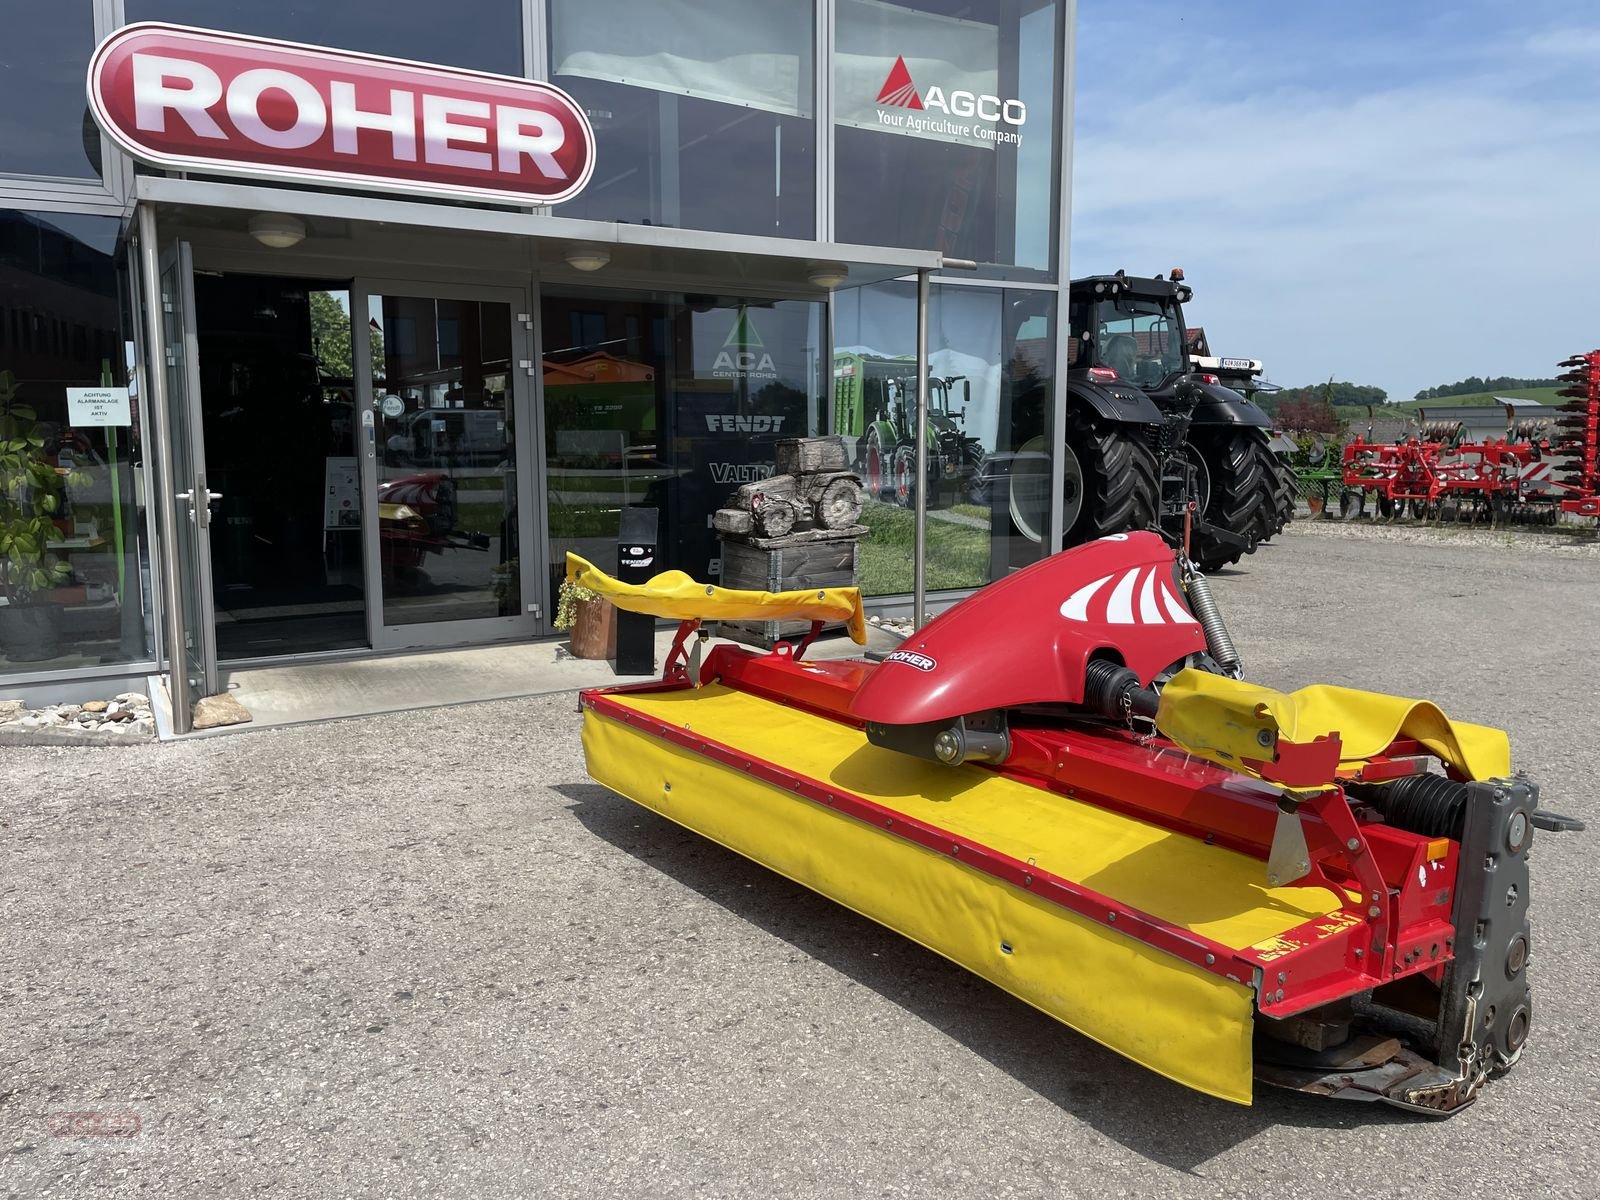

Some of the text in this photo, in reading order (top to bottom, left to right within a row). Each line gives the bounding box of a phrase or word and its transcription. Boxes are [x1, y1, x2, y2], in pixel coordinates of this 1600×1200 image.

[132, 53, 568, 180] ROHER
[923, 86, 1027, 126] AGCO
[877, 110, 1024, 148] Your Agriculture Company
[712, 351, 776, 372] ACA
[750, 371, 777, 379] ROHER
[705, 415, 786, 433] FENDT
